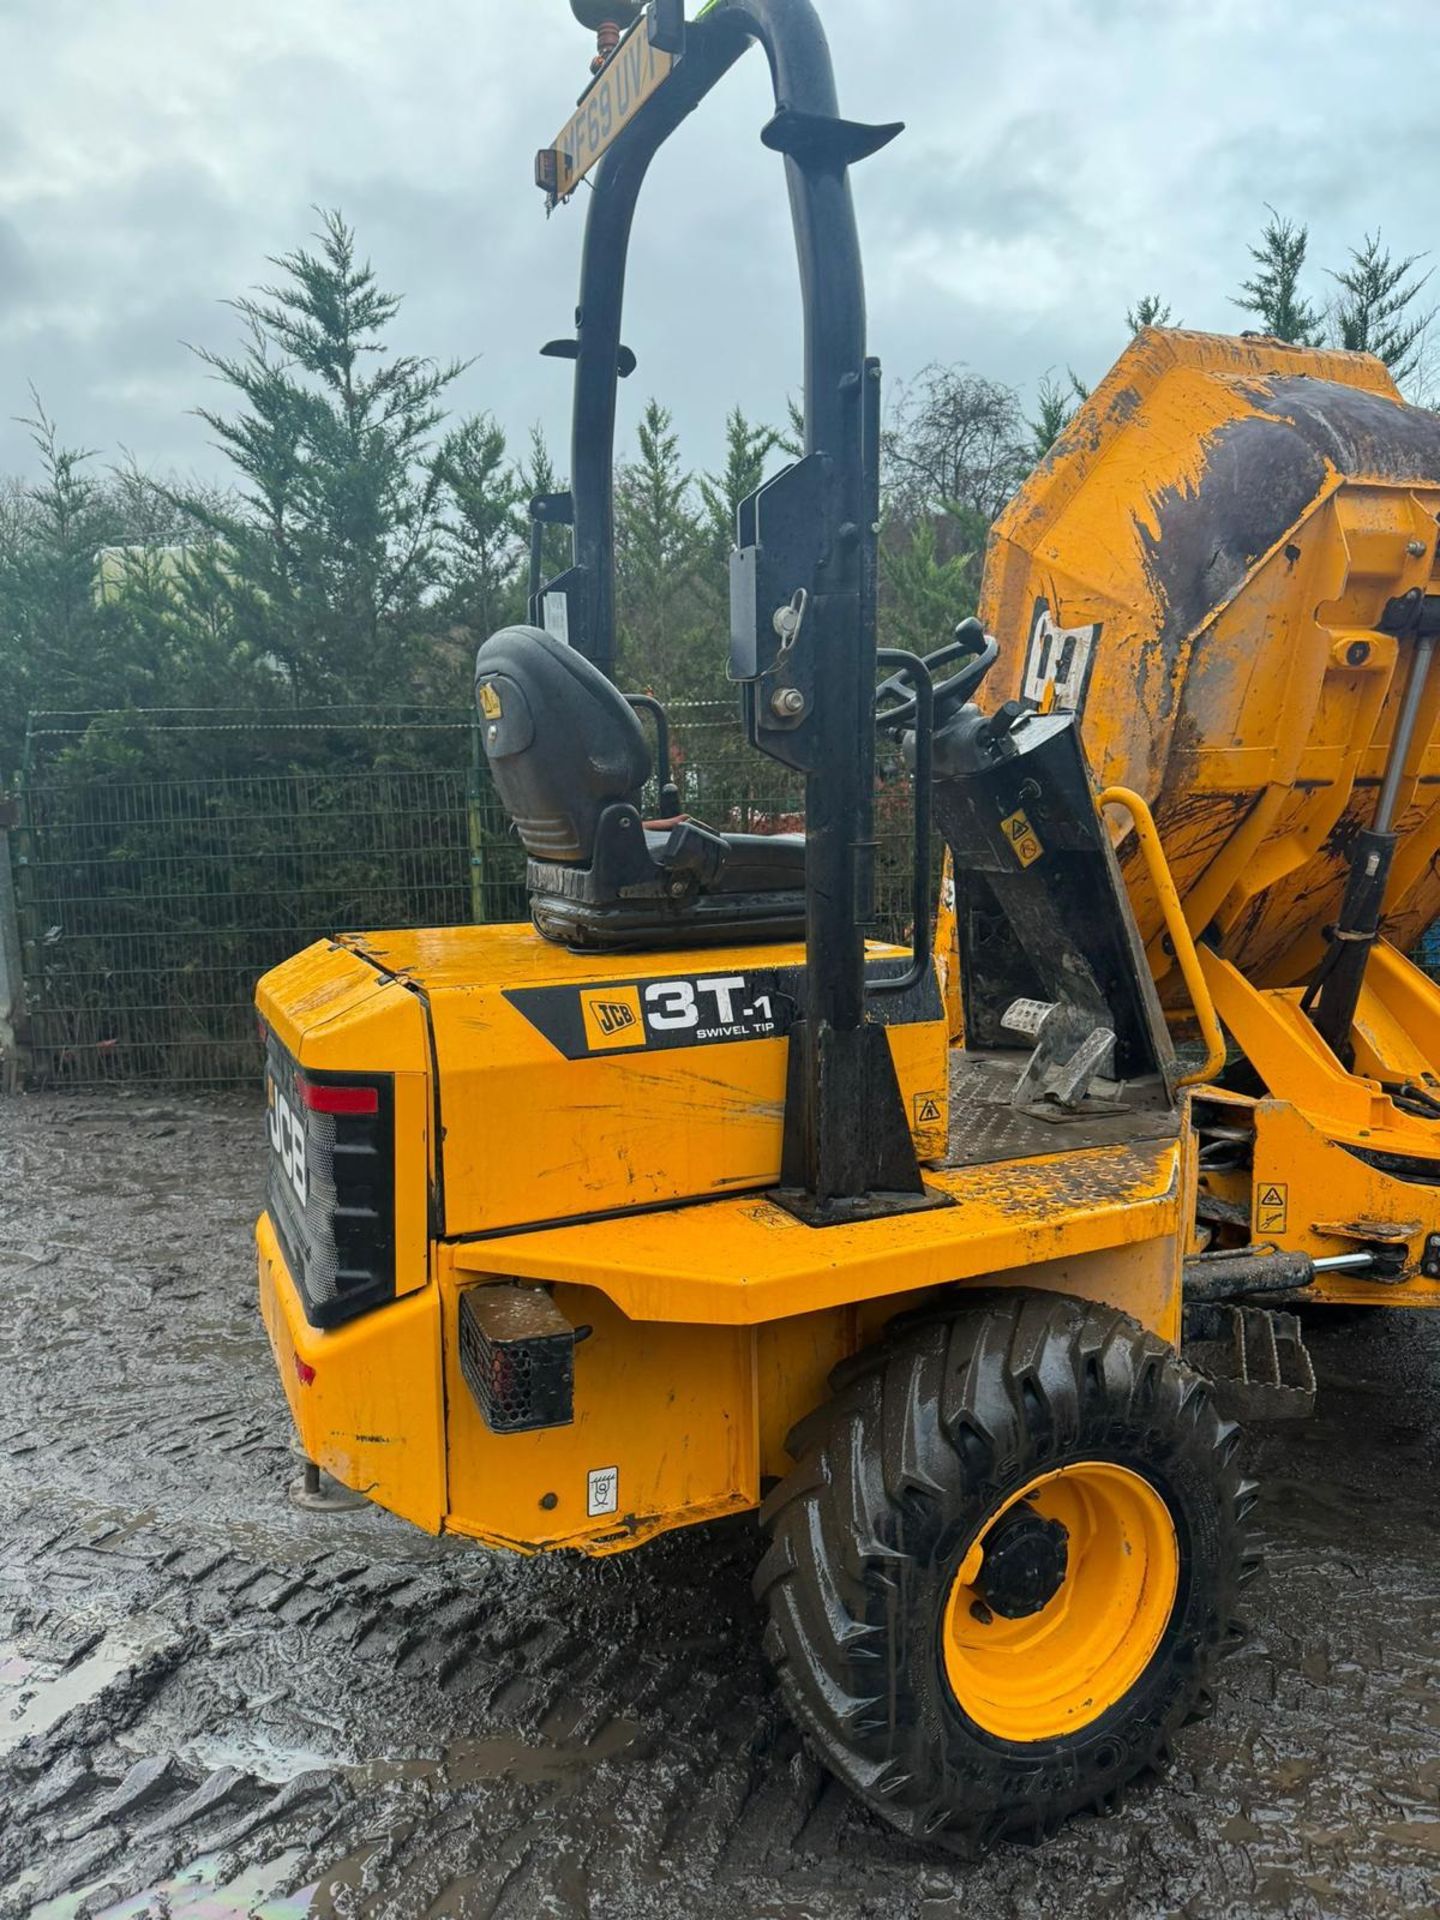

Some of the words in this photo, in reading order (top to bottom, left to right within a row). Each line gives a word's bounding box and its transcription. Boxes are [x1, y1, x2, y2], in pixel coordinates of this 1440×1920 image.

[599, 1003, 632, 1032] JCB
[696, 1025, 750, 1039] SWIVEL
[753, 1022, 775, 1033] TIP
[269, 1084, 306, 1208] JCB
